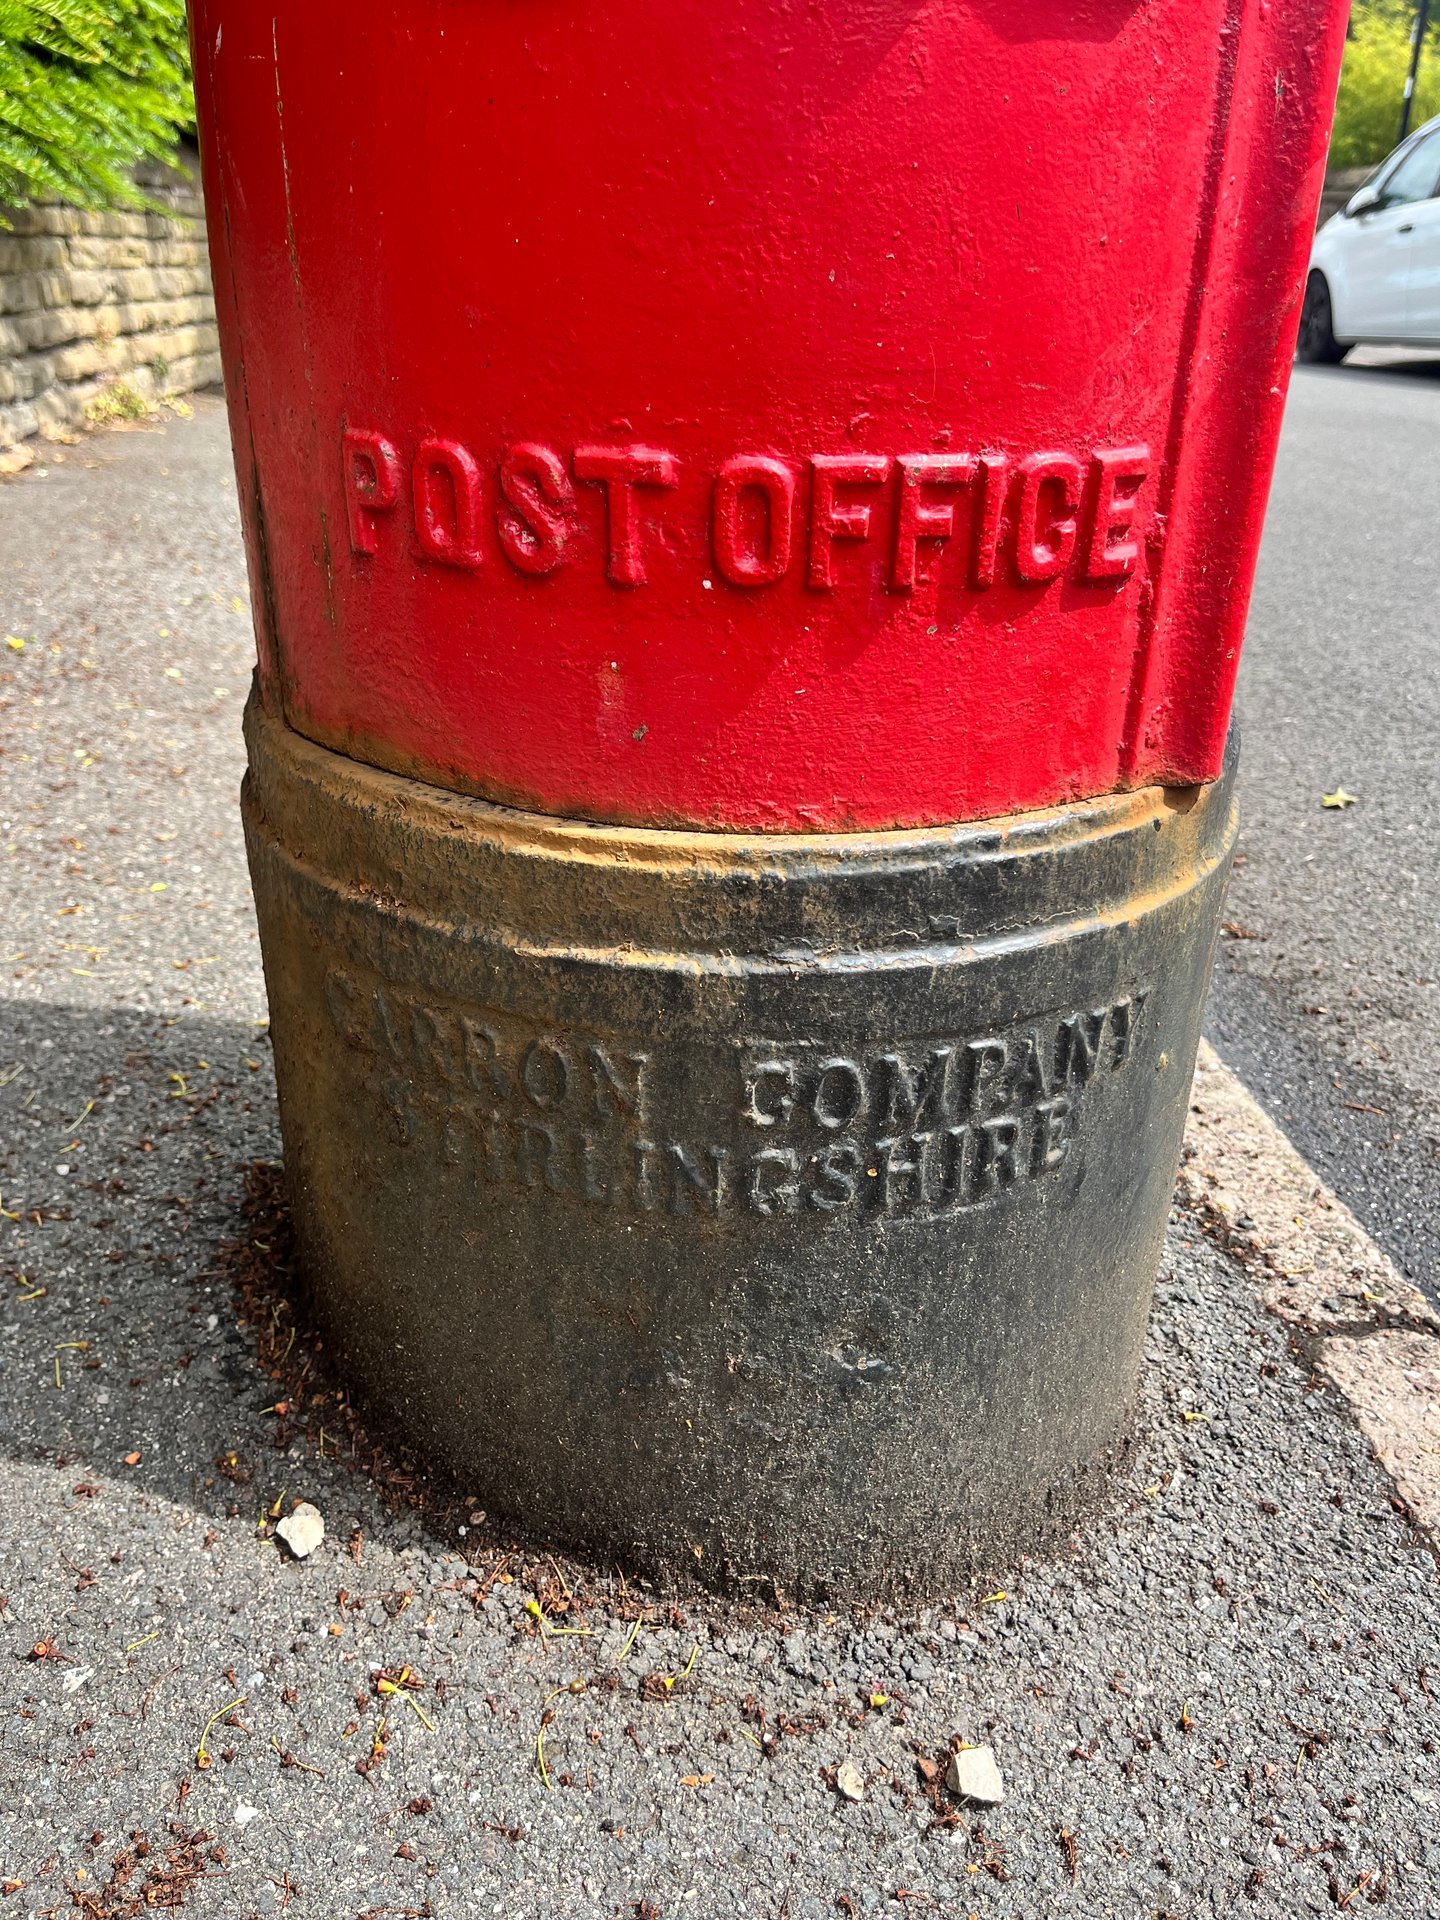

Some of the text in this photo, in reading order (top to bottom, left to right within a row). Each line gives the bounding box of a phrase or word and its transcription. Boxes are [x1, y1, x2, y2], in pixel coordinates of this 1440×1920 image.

[342, 427, 1153, 592] POST OFFICE
[743, 985, 1153, 1128] COMPANY
